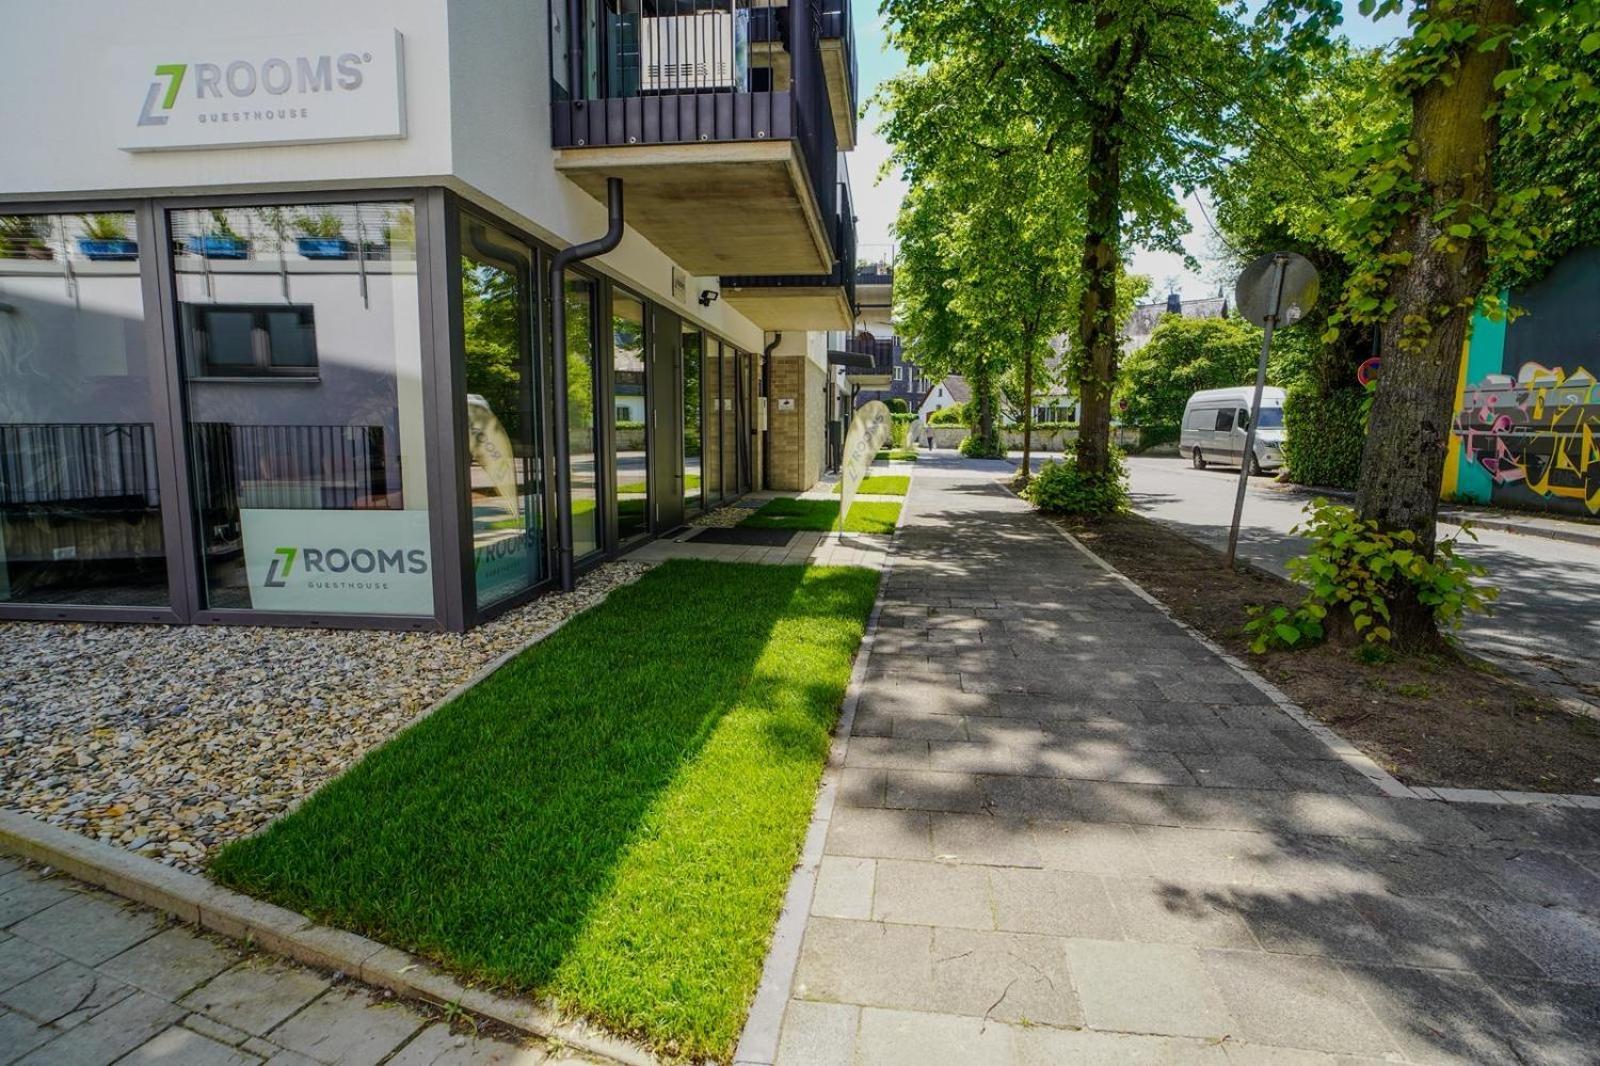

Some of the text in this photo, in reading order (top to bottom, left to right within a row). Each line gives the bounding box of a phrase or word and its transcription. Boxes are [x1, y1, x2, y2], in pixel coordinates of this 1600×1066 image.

[198, 108, 308, 123] GUESTHOUSE
[303, 548, 428, 575] ROOMS
[307, 581, 389, 590] GUESTHOUSE
